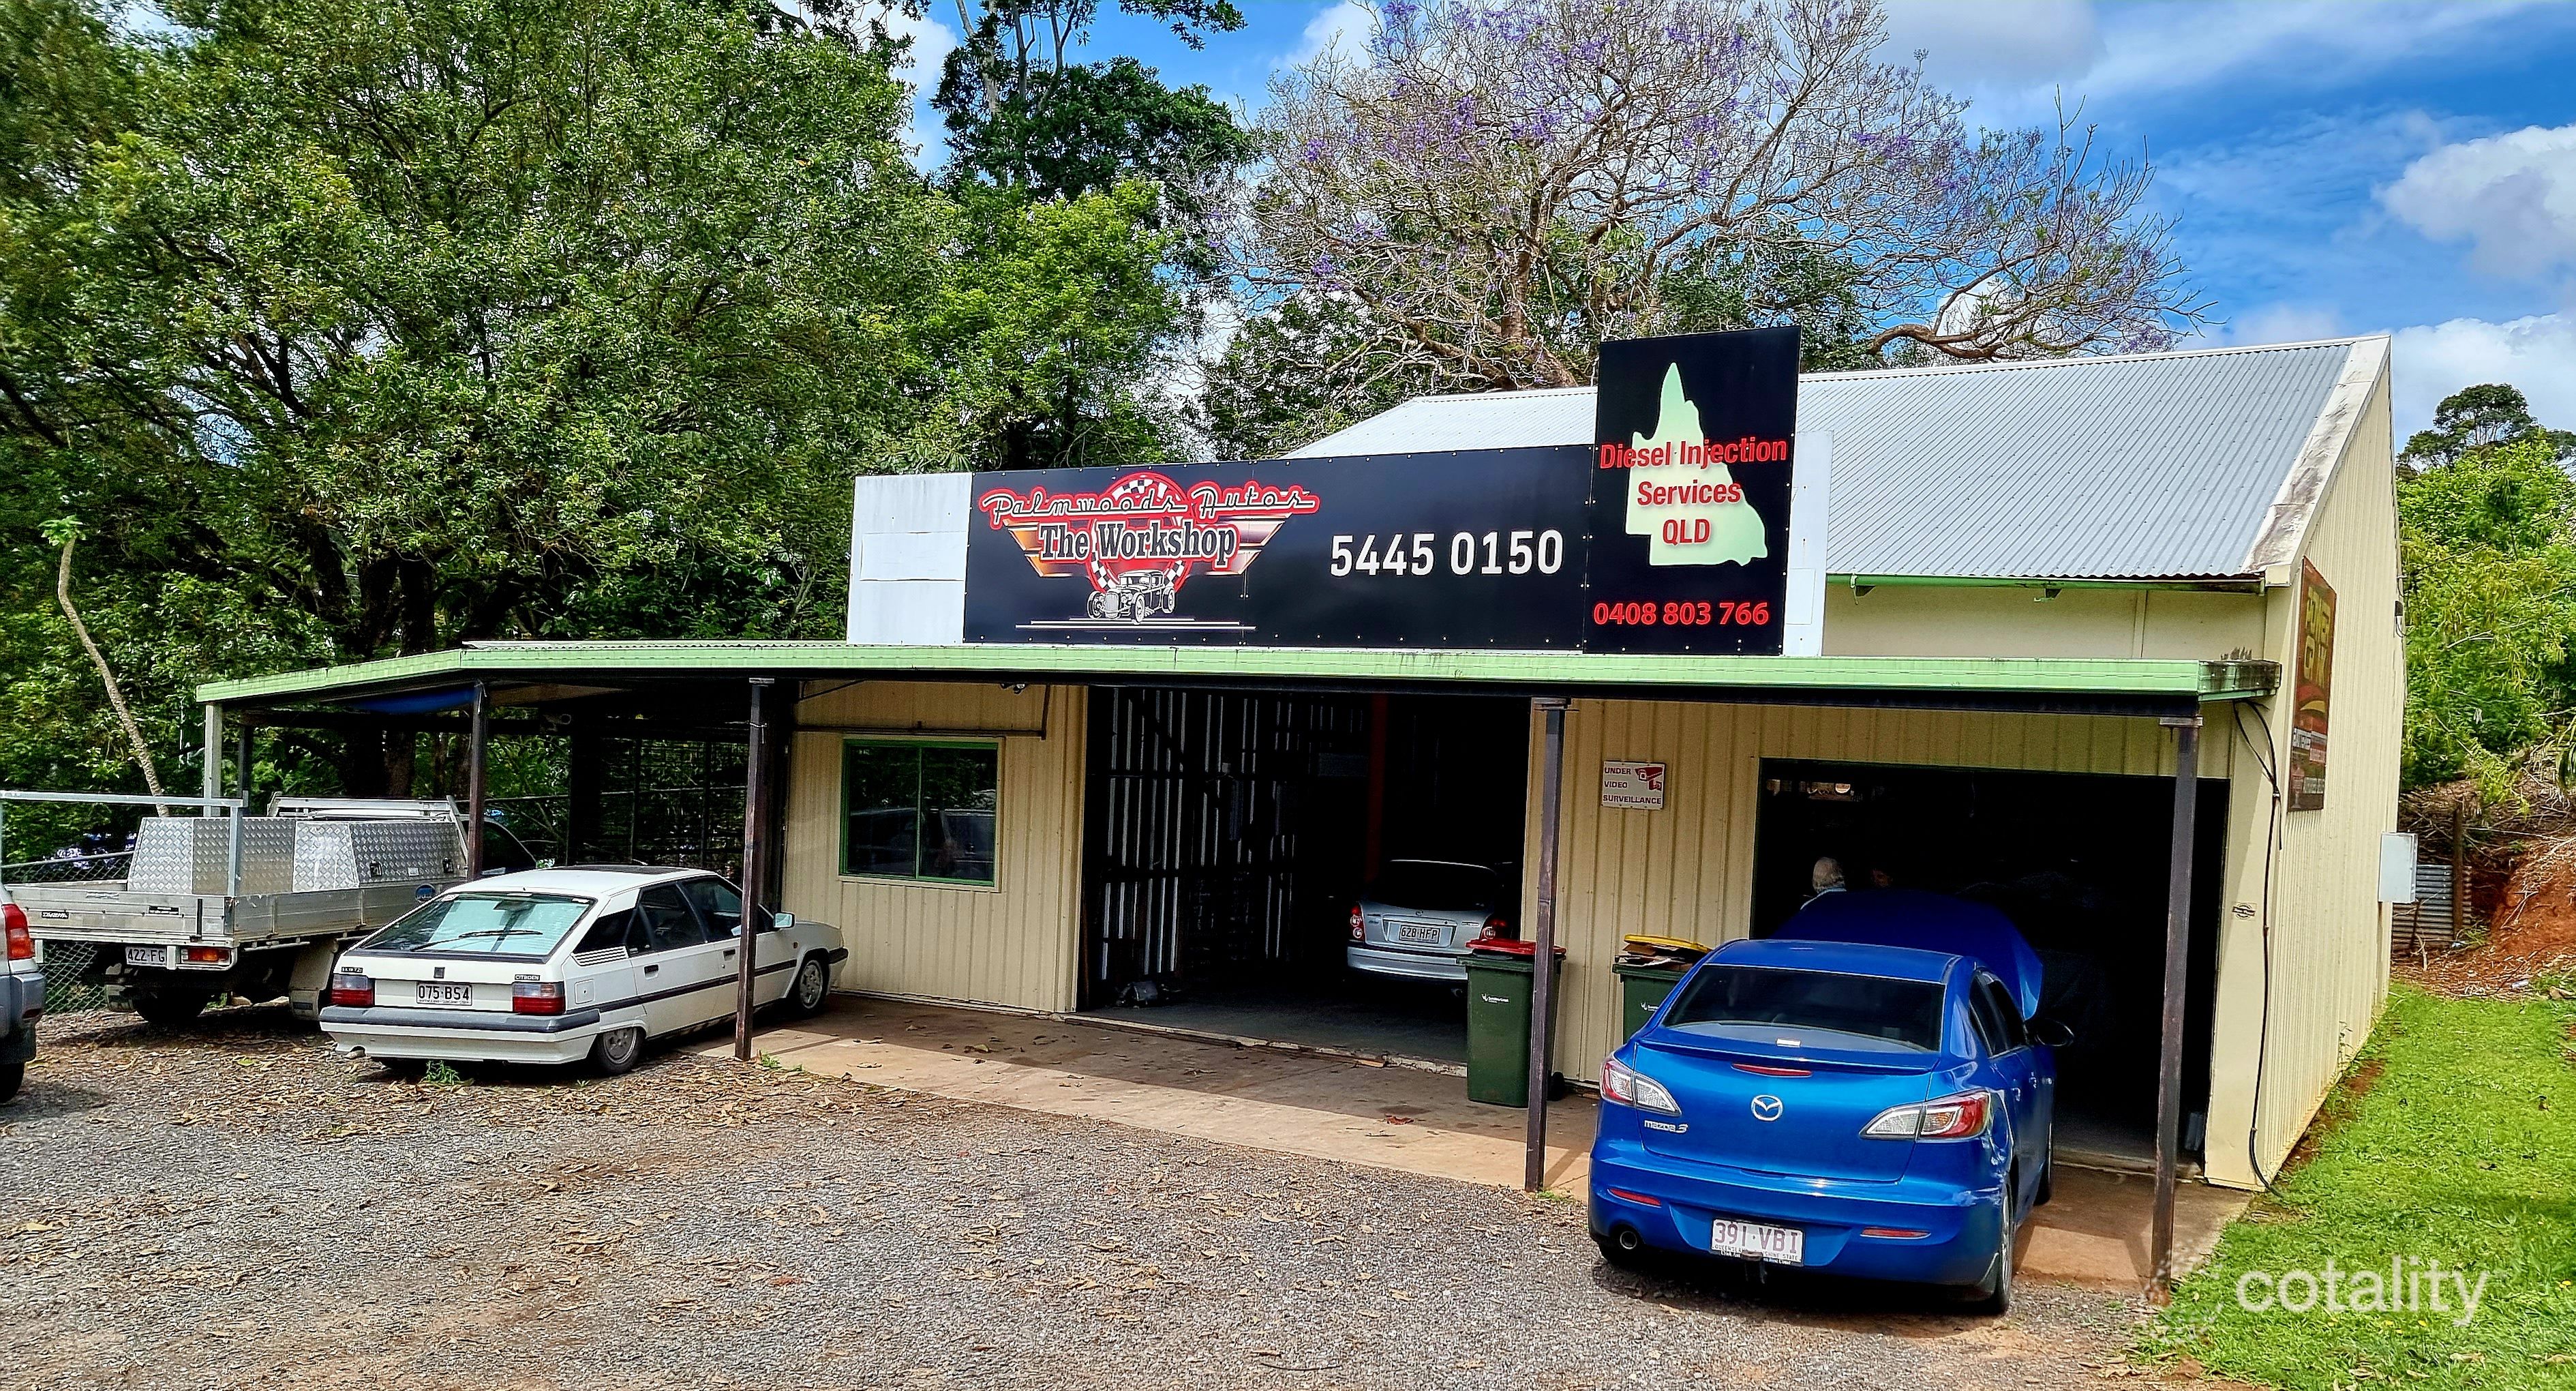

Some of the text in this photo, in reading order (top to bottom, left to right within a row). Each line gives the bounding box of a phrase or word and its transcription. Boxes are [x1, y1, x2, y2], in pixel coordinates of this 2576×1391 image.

[1599, 438, 1787, 469] Diesel Injection
[981, 486, 1316, 524] Palmwoods Autos
[1637, 481, 1742, 507] Services
[1038, 520, 1237, 568] The Workshop
[1662, 519, 1711, 545] QLD
[1330, 529, 1564, 577] 5445 0150
[1593, 601, 1770, 625] 0408 803 766
[1603, 794, 1662, 805] SURVEILLANCE
